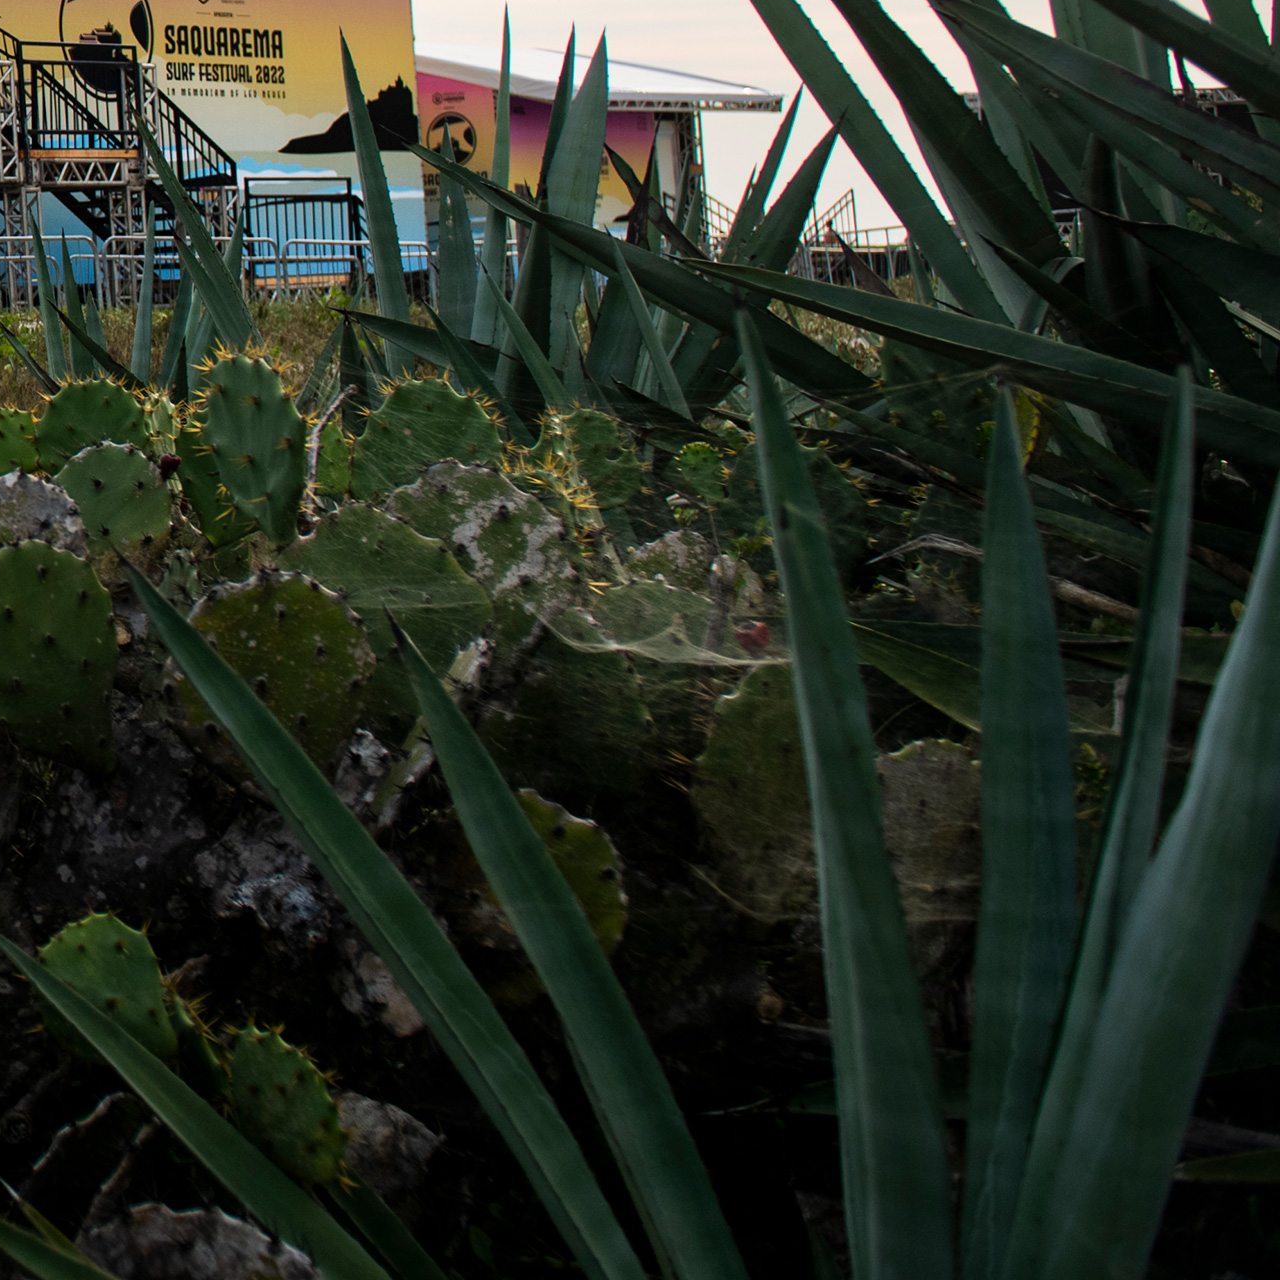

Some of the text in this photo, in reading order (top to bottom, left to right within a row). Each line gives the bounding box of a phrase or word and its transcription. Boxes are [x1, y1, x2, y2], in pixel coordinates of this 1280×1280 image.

[164, 25, 284, 59] SAQUAREMA
[166, 62, 286, 84] SURF FESTIVAL 2022
[167, 87, 287, 99] IN MEMORIAM OF LEO NEVES
